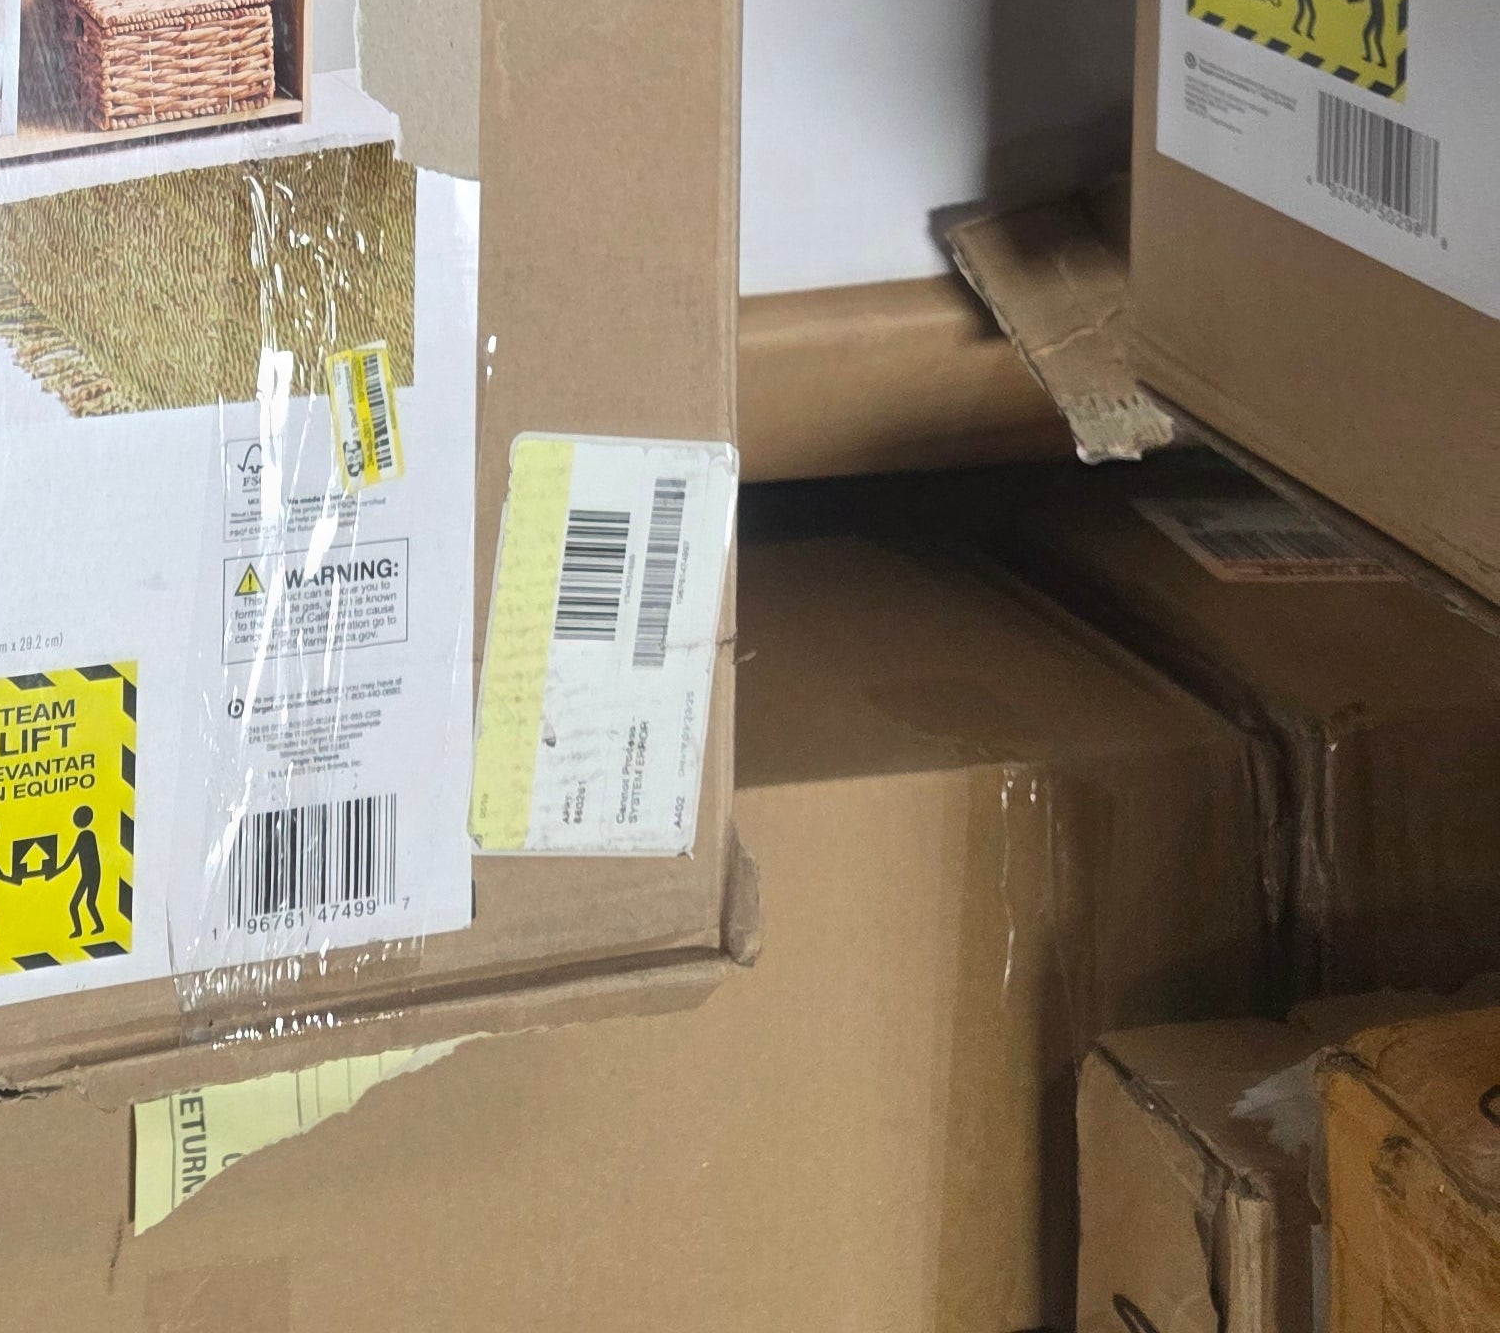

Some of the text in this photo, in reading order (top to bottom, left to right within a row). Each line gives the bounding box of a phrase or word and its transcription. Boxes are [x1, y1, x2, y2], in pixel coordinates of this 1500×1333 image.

[285, 558, 399, 590] WARNING:
[361, 582, 378, 594] you
[380, 580, 390, 591] to
[365, 592, 397, 605] known
[366, 603, 394, 616] cause
[372, 618, 385, 630] go
[387, 616, 397, 627] to
[11, 641, 17, 652] x
[45, 632, 63, 648] cm)
[0, 722, 77, 757] LIFT
[13, 773, 96, 802] EQUIPO
[247, 910, 305, 935] 96761
[317, 898, 377, 923] 47499
[402, 895, 410, 911] 7
